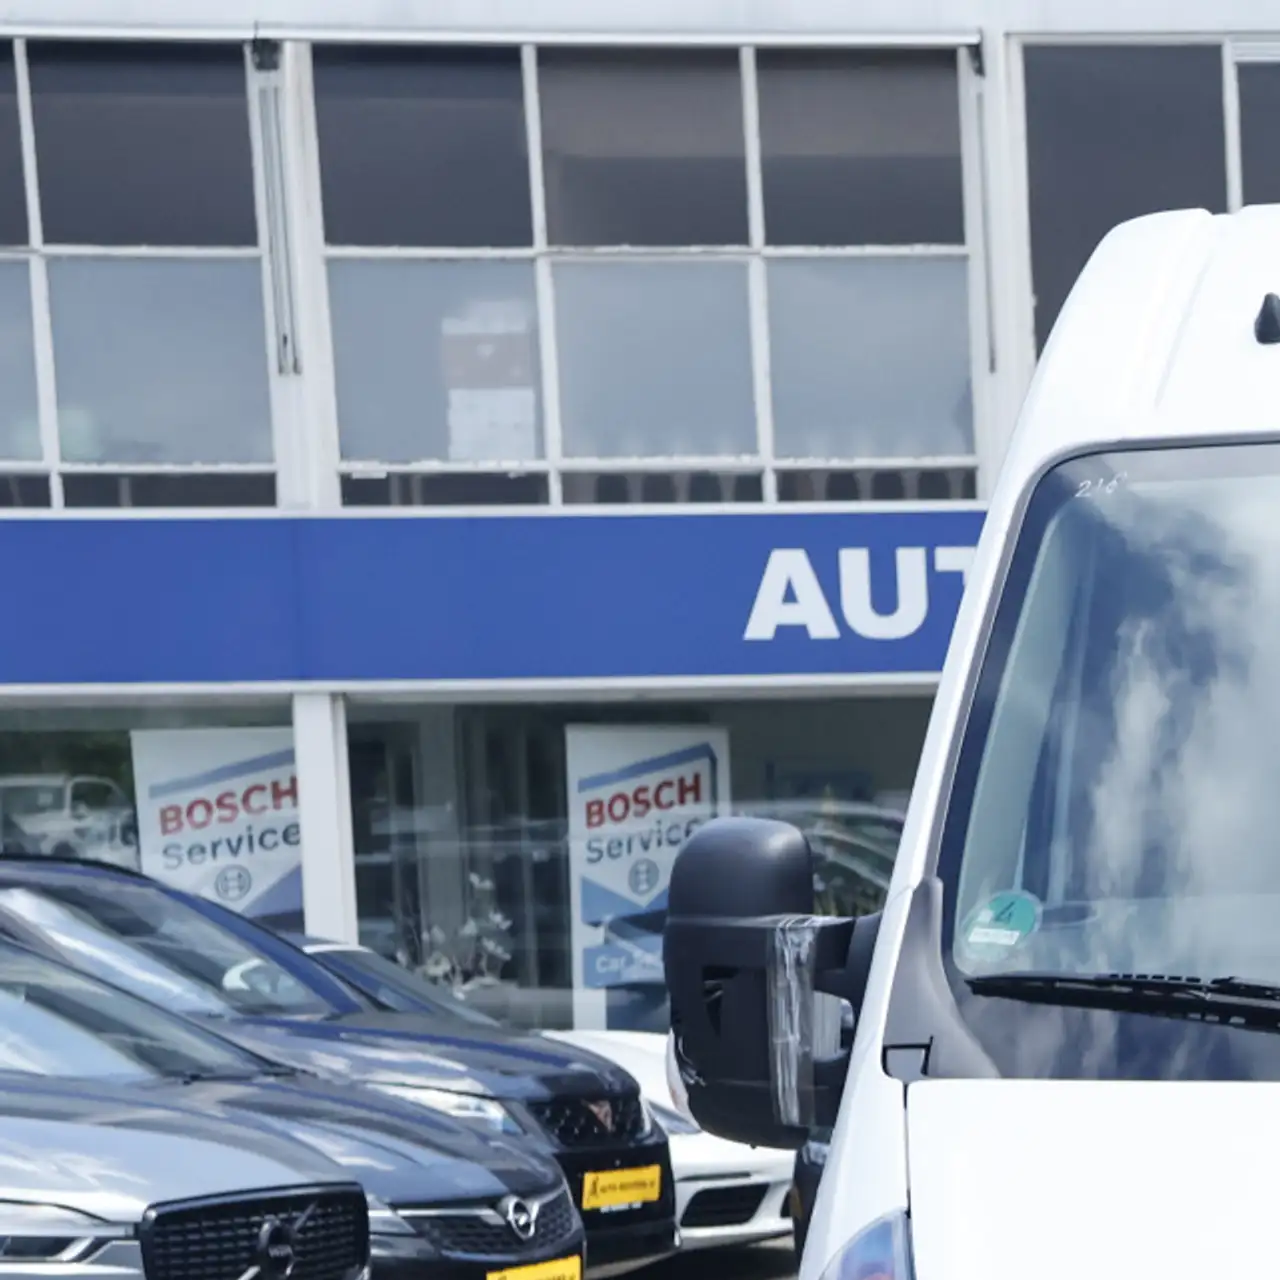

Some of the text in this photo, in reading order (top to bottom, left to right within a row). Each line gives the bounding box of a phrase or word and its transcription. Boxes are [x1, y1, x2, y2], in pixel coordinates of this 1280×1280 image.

[159, 776, 298, 836] BOSCH
[585, 772, 702, 829] BOSCH
[162, 823, 300, 870] Service
